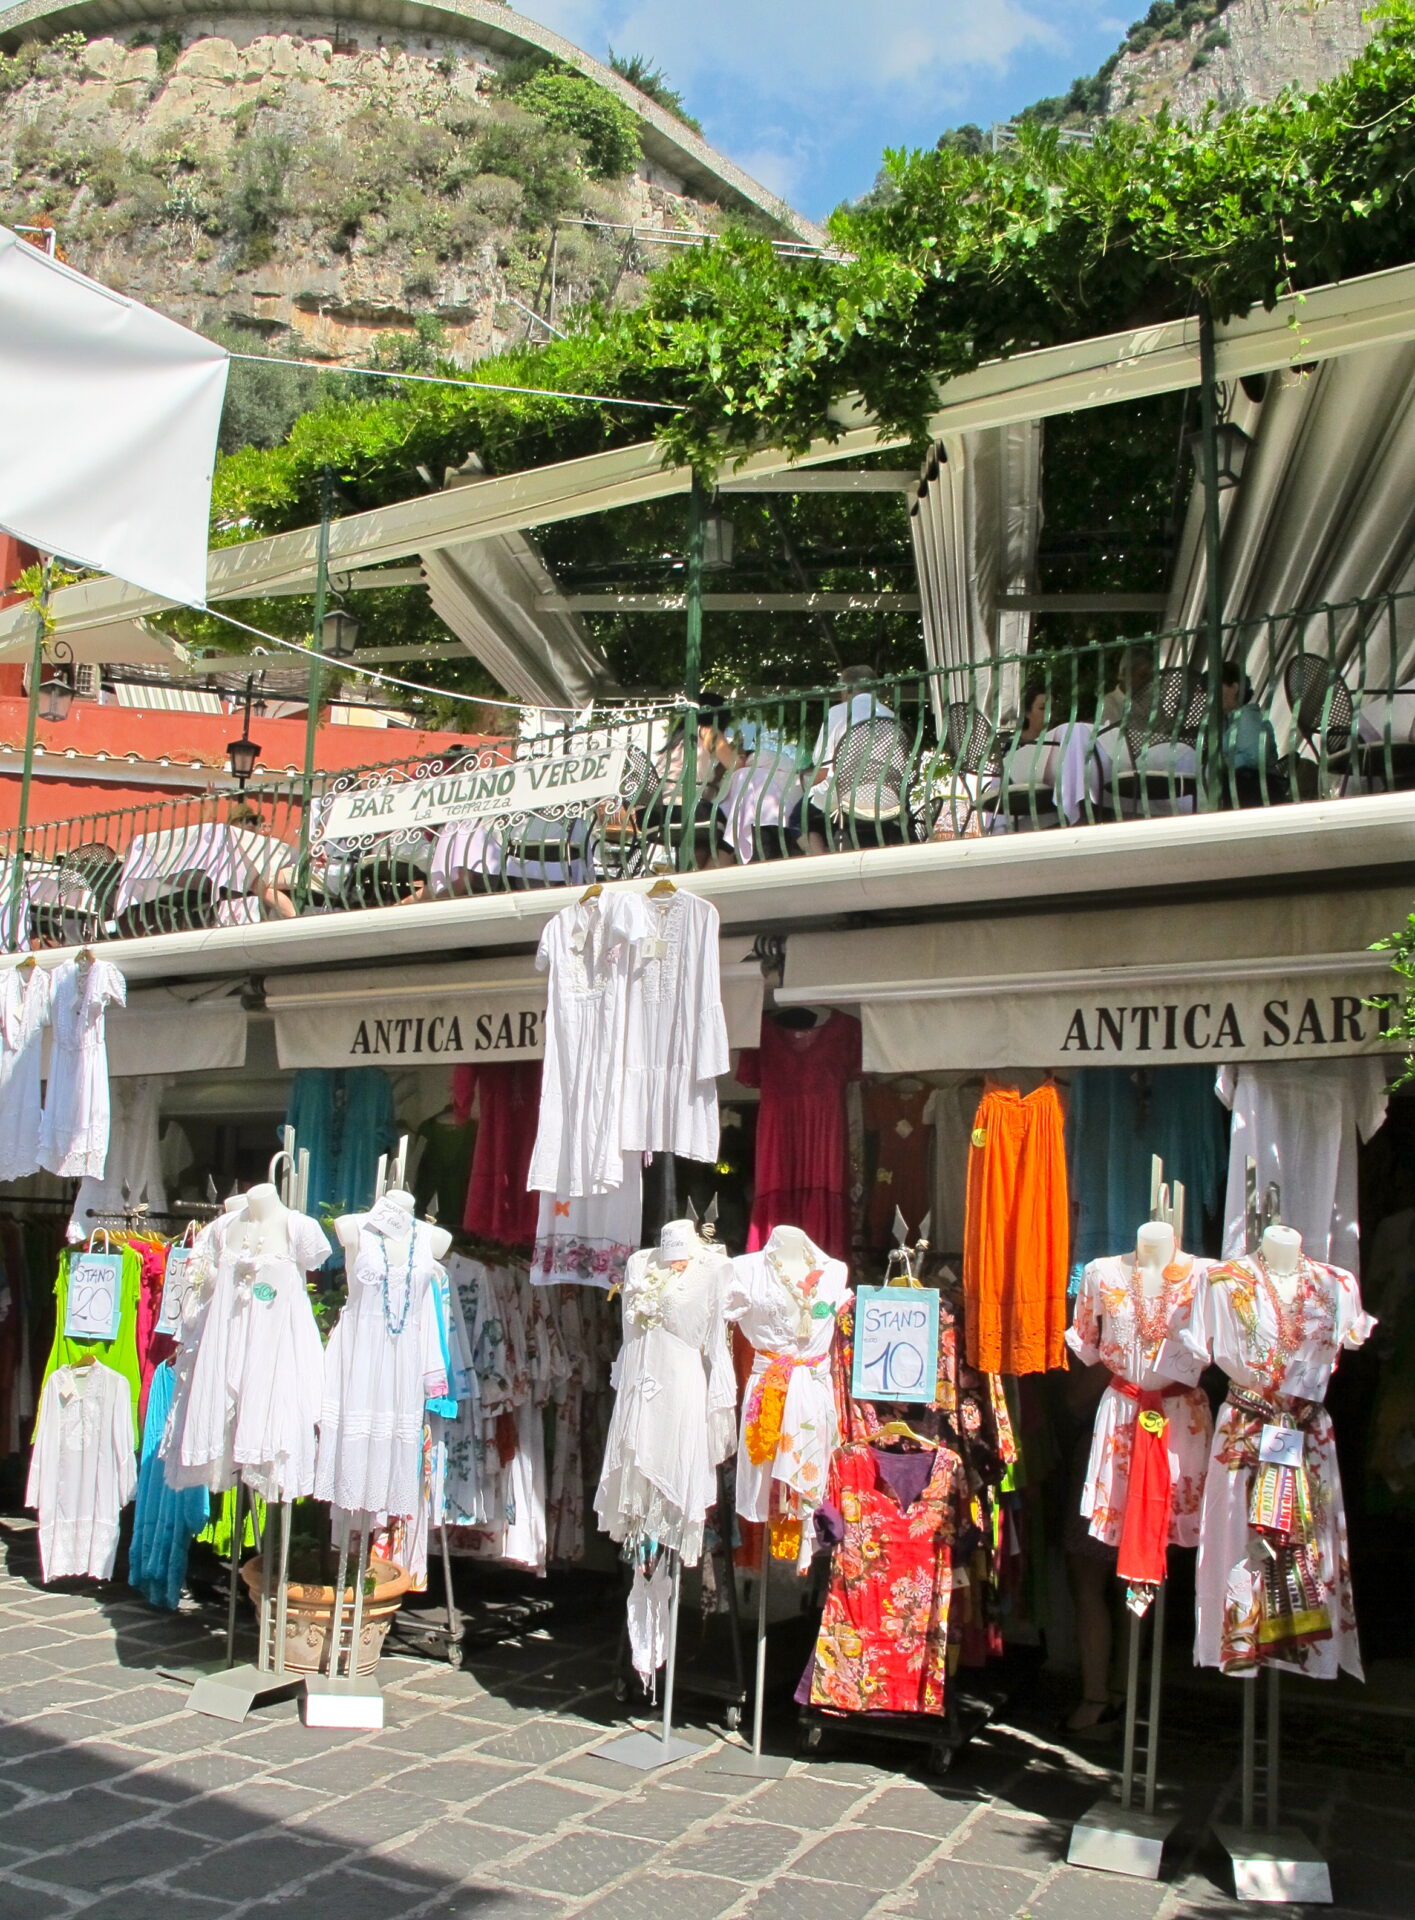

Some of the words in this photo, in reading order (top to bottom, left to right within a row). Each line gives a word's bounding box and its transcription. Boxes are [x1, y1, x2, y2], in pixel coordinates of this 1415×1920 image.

[347, 794, 395, 819] BAR
[410, 770, 516, 810] MULINO
[528, 754, 611, 790] VERDE
[350, 1014, 463, 1055] ANTICA
[475, 1009, 546, 1051] SAR
[1060, 1003, 1246, 1051] ANTICA
[75, 1265, 114, 1284] STAND
[865, 1308, 926, 1331] STAND
